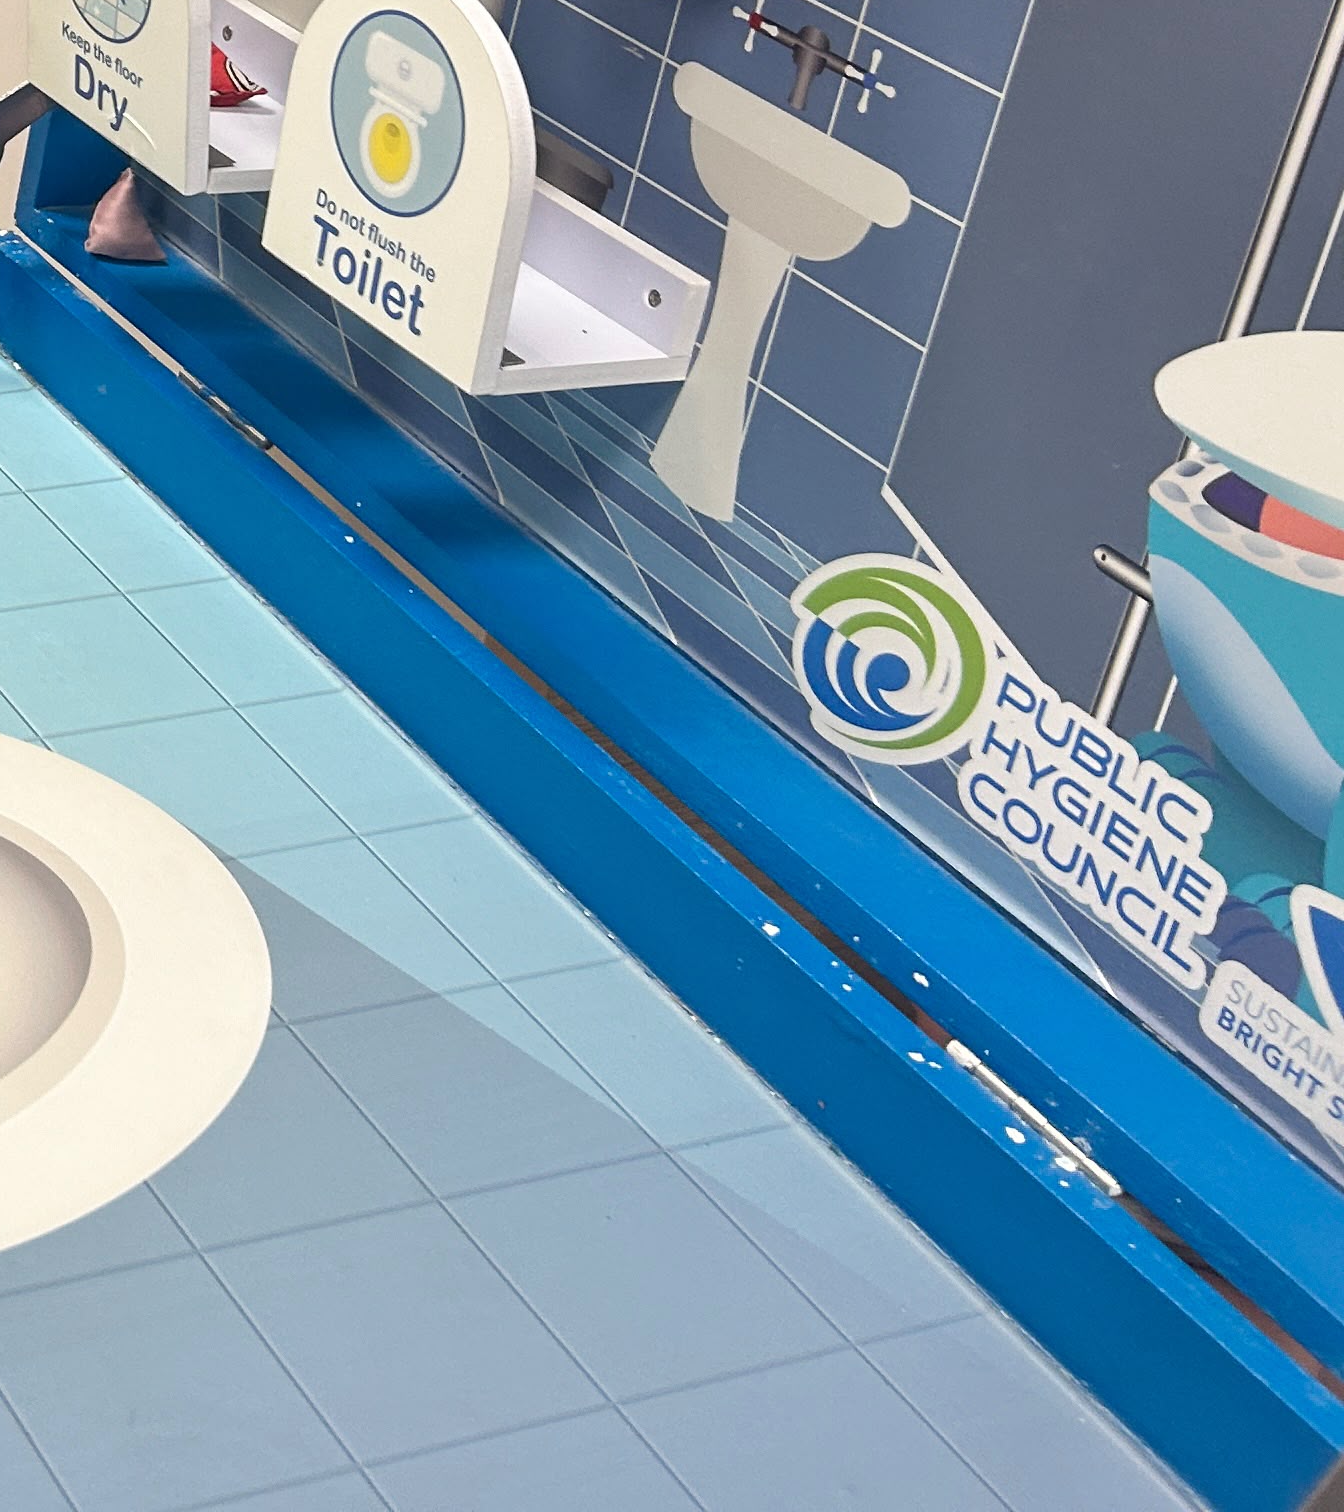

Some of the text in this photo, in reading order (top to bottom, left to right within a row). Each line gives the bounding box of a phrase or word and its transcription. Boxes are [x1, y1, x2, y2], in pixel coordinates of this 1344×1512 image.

[62, 20, 144, 90] Keep the floor
[74, 54, 128, 132] Dry
[313, 214, 425, 336] Toilet
[316, 188, 437, 283] Do not flush the
[996, 672, 1199, 843] PUBLIC
[969, 772, 1193, 973] COUNCIL
[981, 720, 1212, 918] HYGIENE
[1217, 1005, 1325, 1099] BRIGHT
